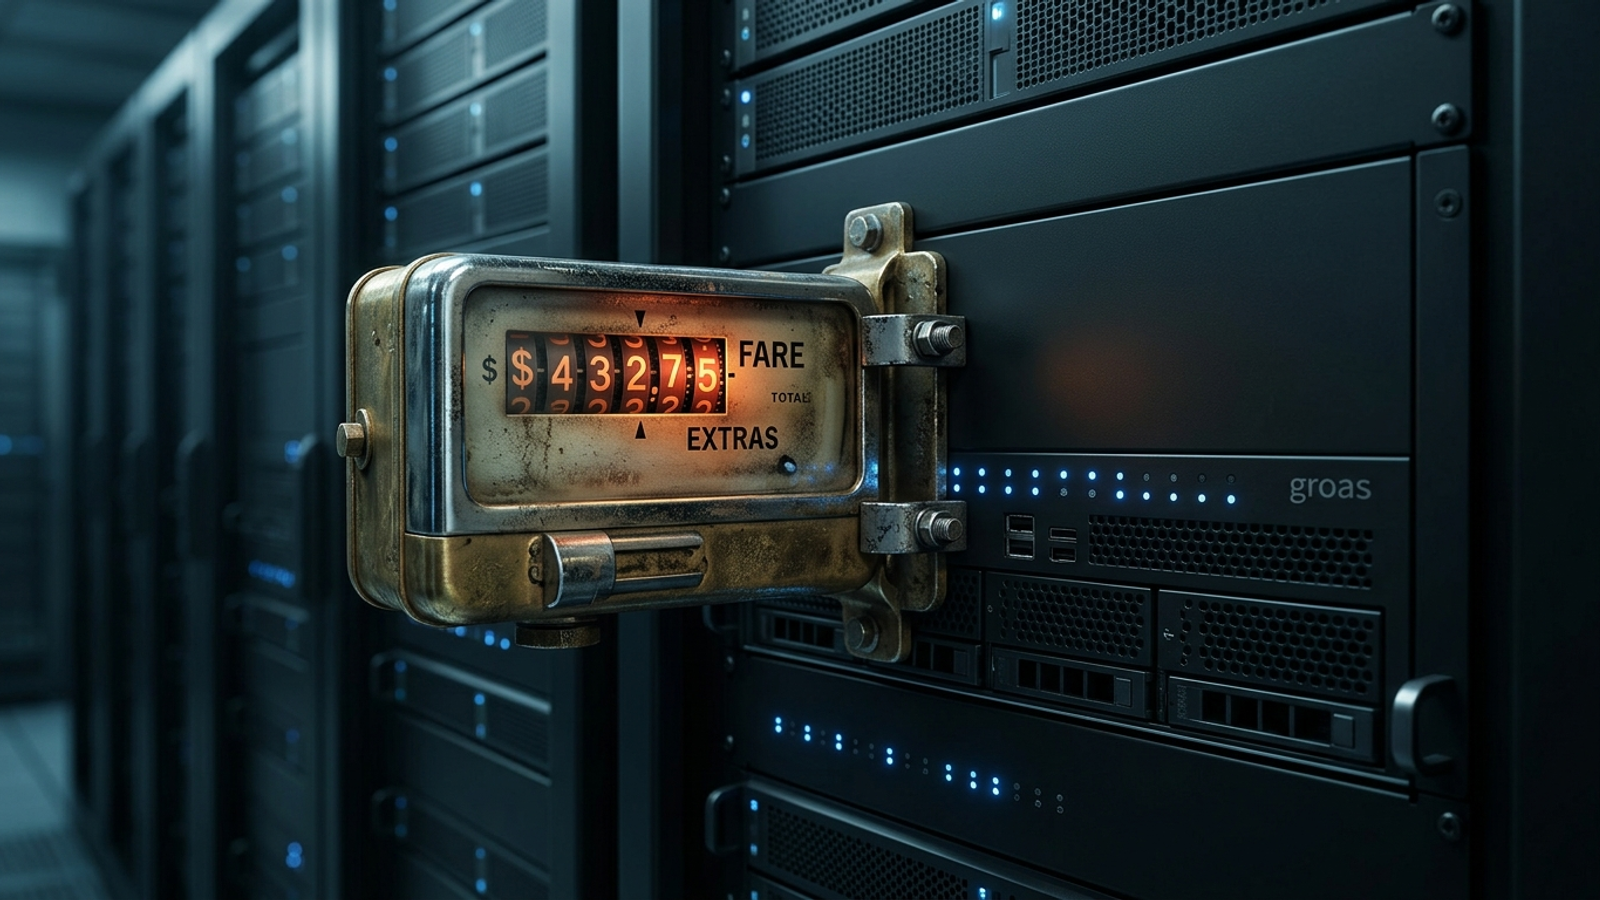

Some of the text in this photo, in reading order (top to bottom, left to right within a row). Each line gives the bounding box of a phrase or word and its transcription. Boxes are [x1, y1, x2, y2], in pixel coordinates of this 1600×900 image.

[739, 341, 805, 369] FARE
[482, 355, 498, 385] $
[687, 426, 779, 451] EXTRAS
[1289, 477, 1372, 504] groas
